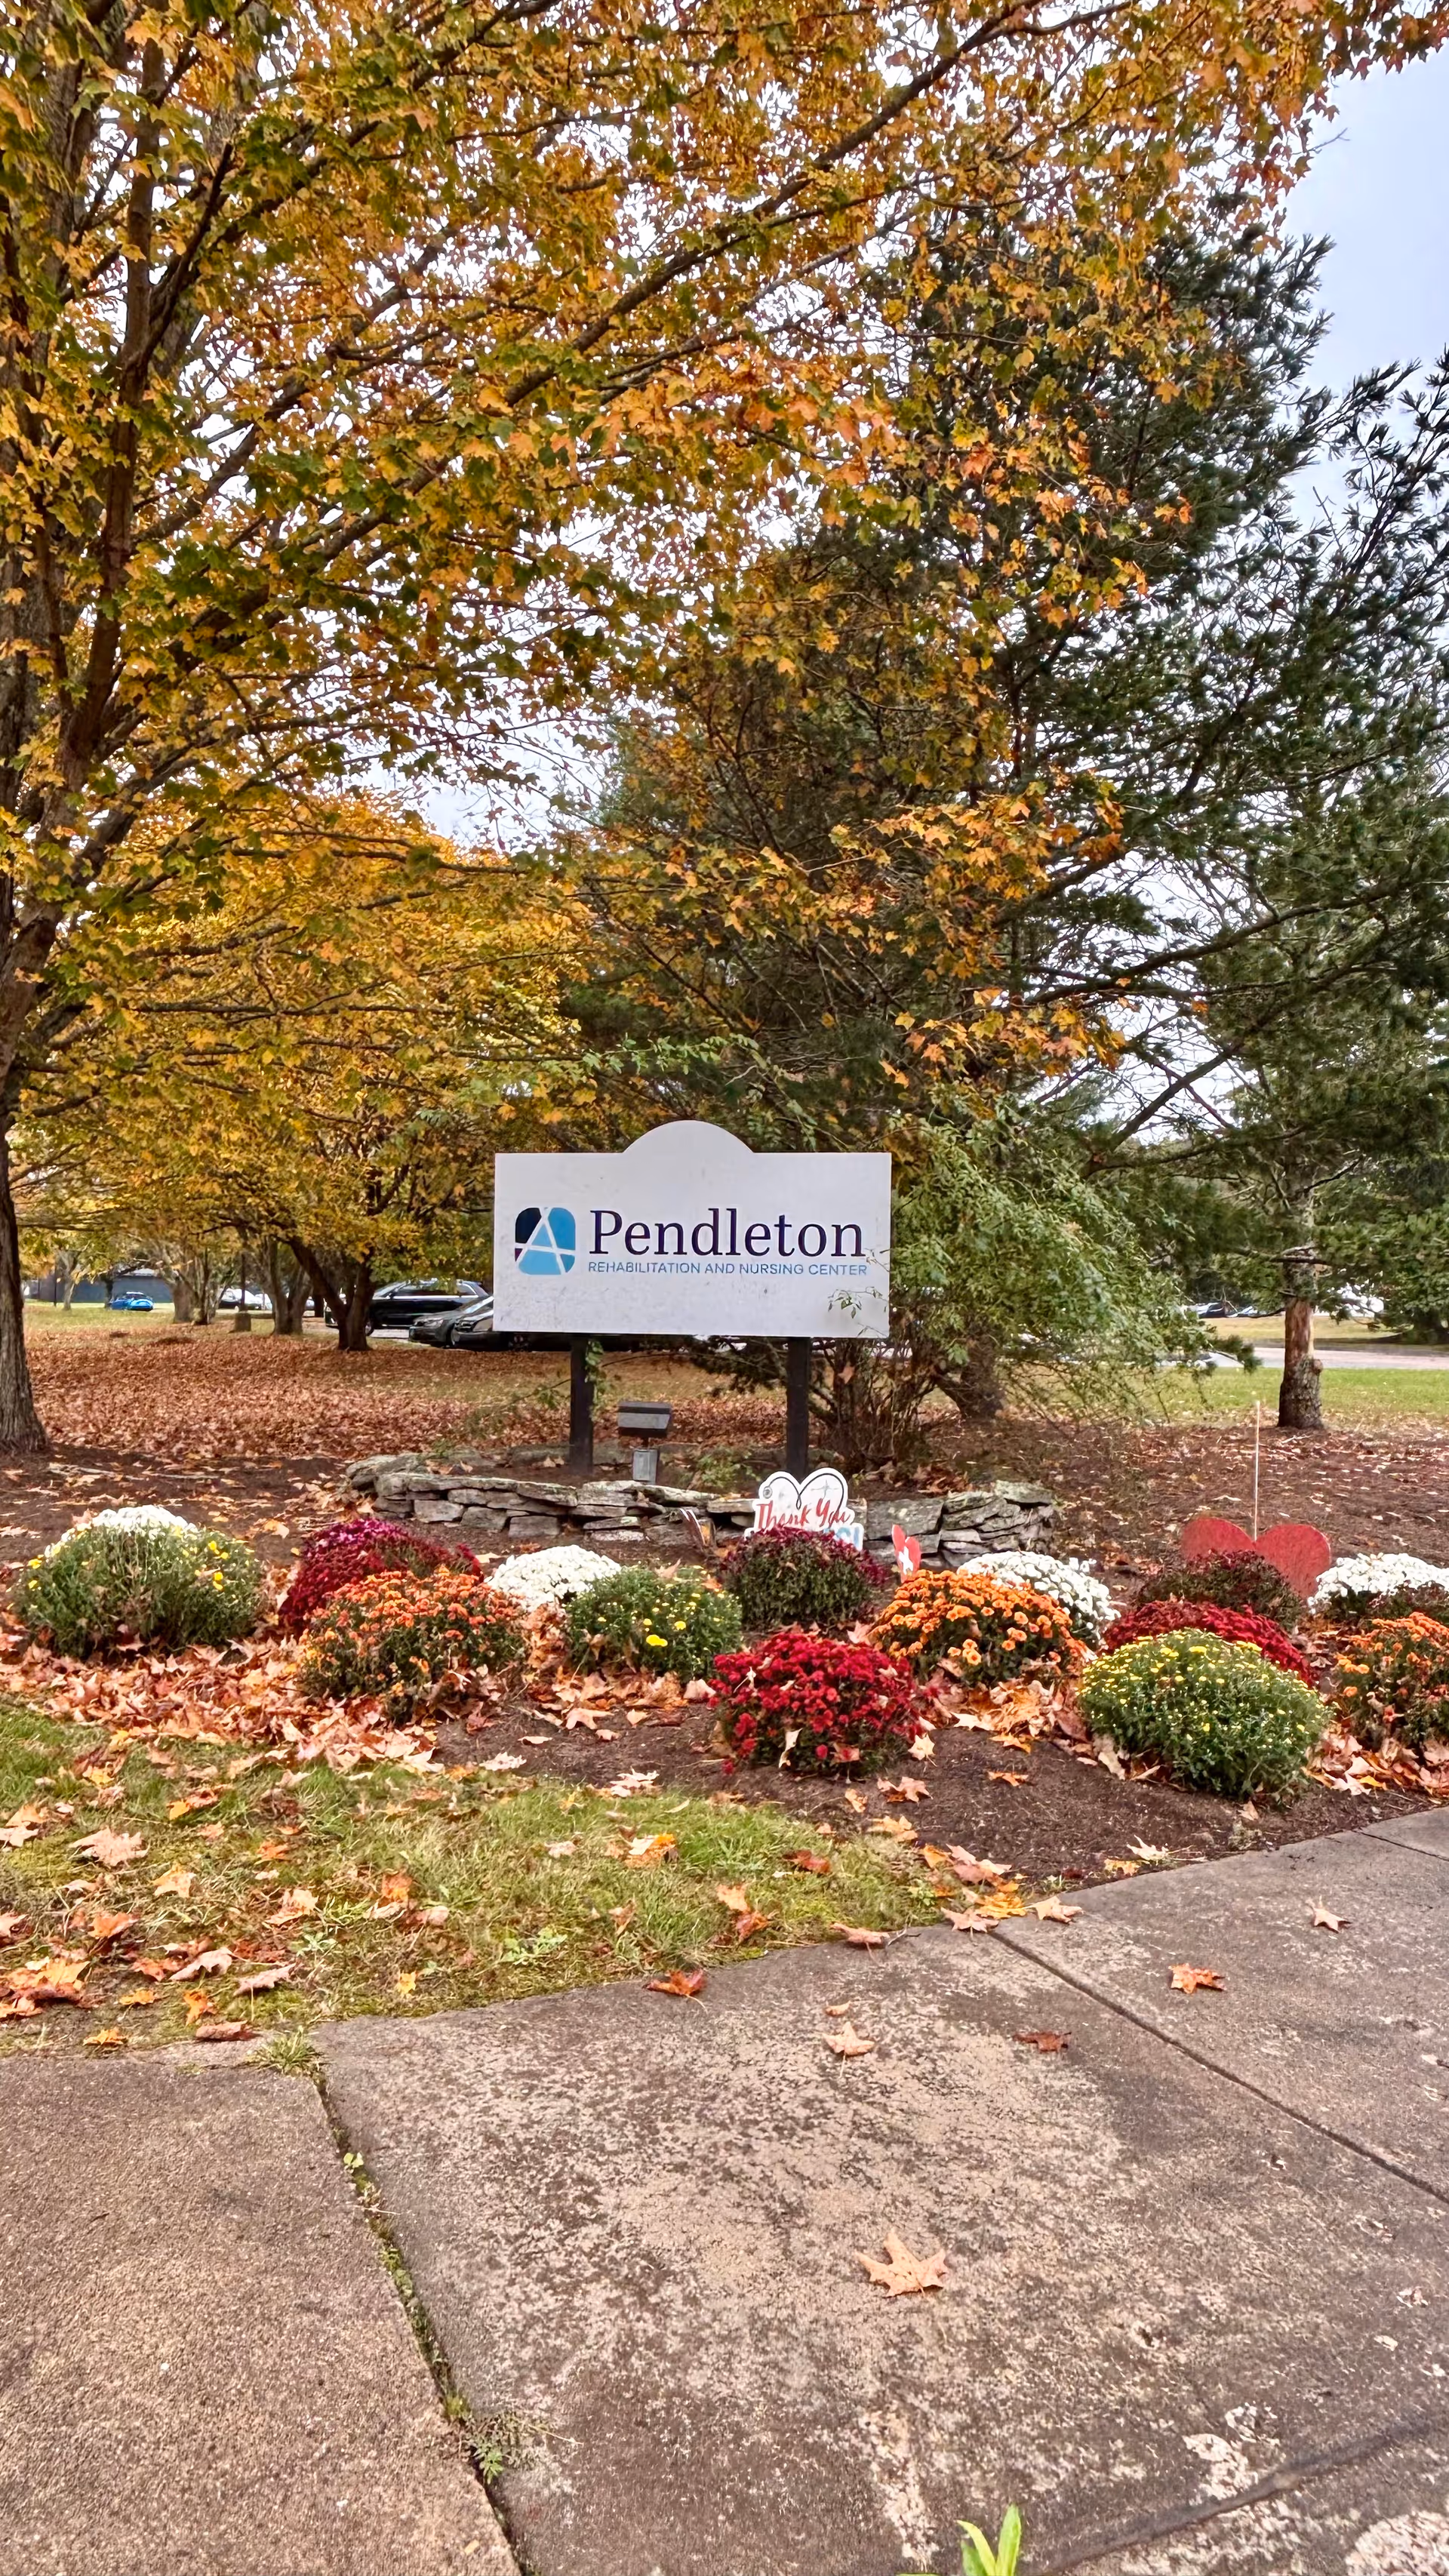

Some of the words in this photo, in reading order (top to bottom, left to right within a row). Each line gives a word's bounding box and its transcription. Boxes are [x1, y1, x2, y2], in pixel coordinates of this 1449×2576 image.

[589, 1208, 866, 1257] Pendleton
[588, 1261, 700, 1273] REHABILITATION
[704, 1263, 734, 1274] AND
[740, 1263, 804, 1275] NURSING
[808, 1264, 867, 1276] CENTER
[756, 1500, 812, 1530] Thank
[815, 1497, 851, 1529] You
